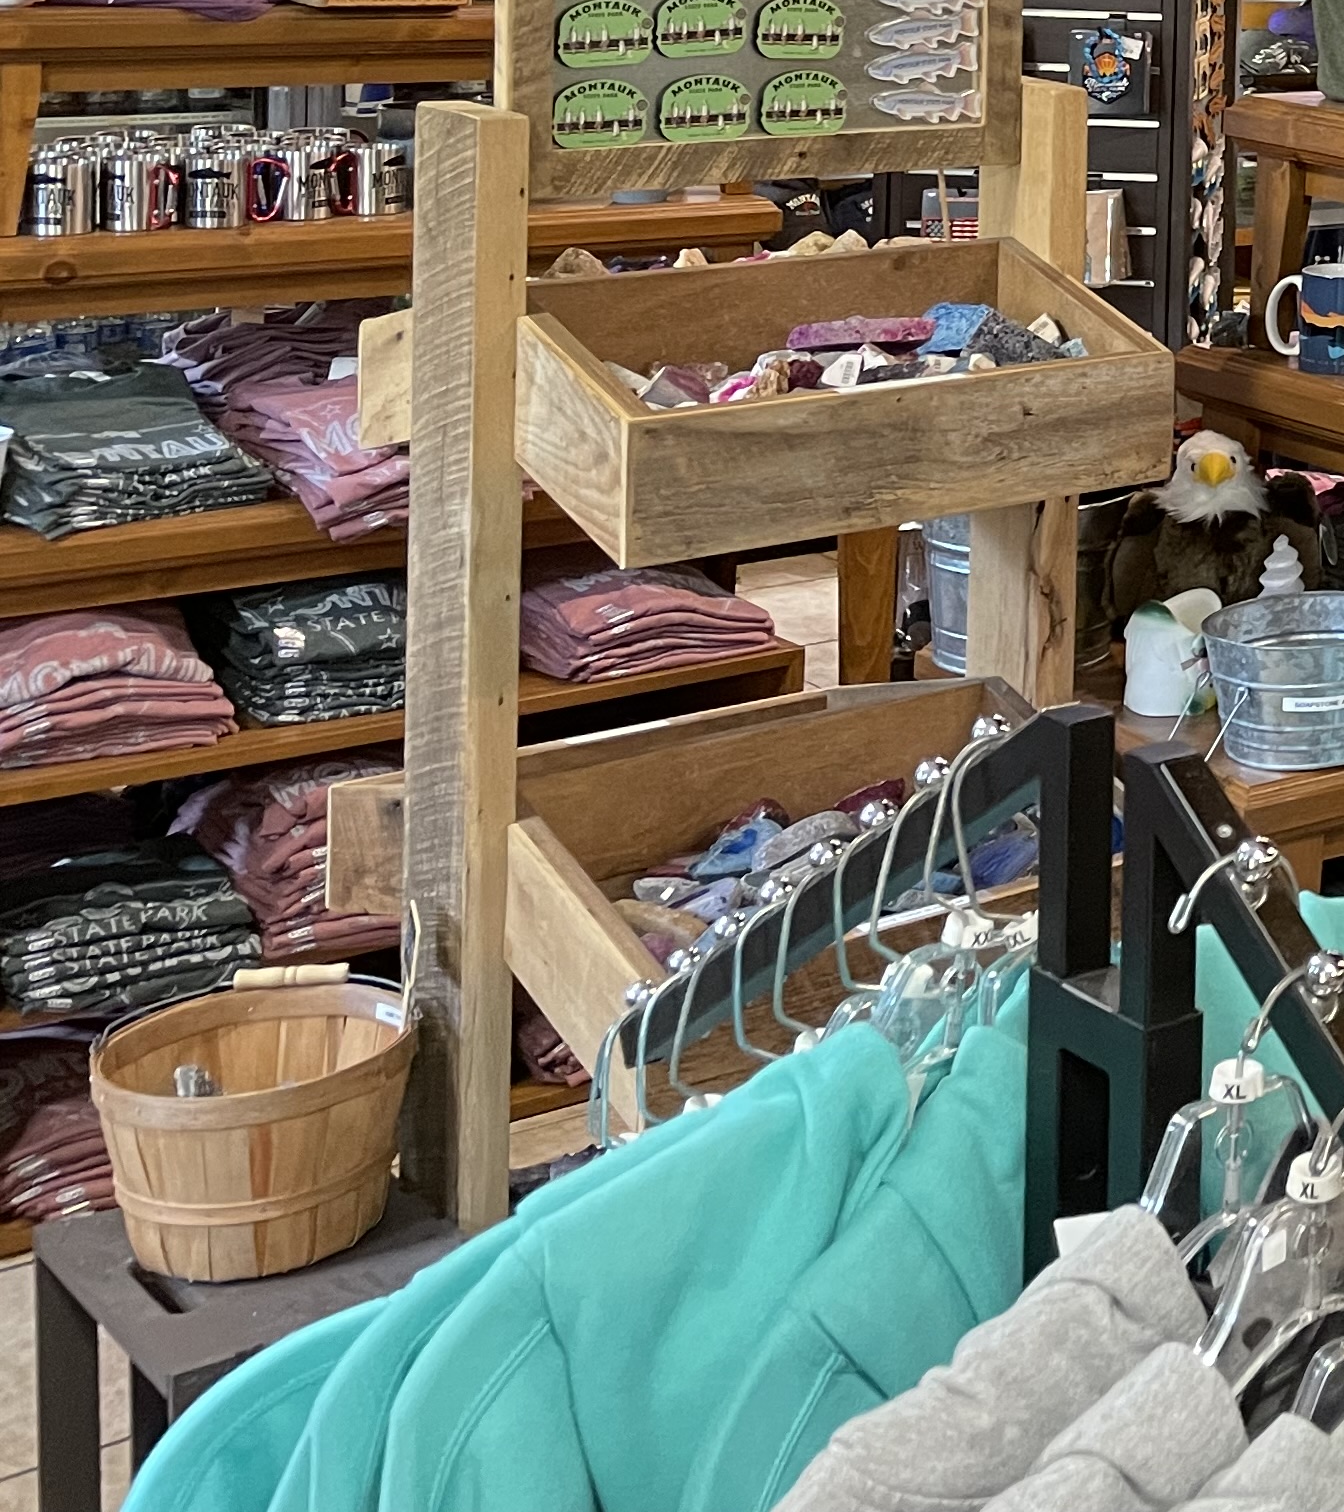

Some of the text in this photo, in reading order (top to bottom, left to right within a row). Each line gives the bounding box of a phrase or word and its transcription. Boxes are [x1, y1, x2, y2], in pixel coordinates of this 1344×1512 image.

[569, 1, 642, 22] MONTAUK
[671, 77, 742, 97] MONTAUK
[772, 72, 839, 92] MONTAUK
[564, 82, 637, 103] MONTAUK
[306, 609, 385, 634] STATE
[1223, 1082, 1247, 1100] XL
[1299, 1182, 1319, 1200] XL
